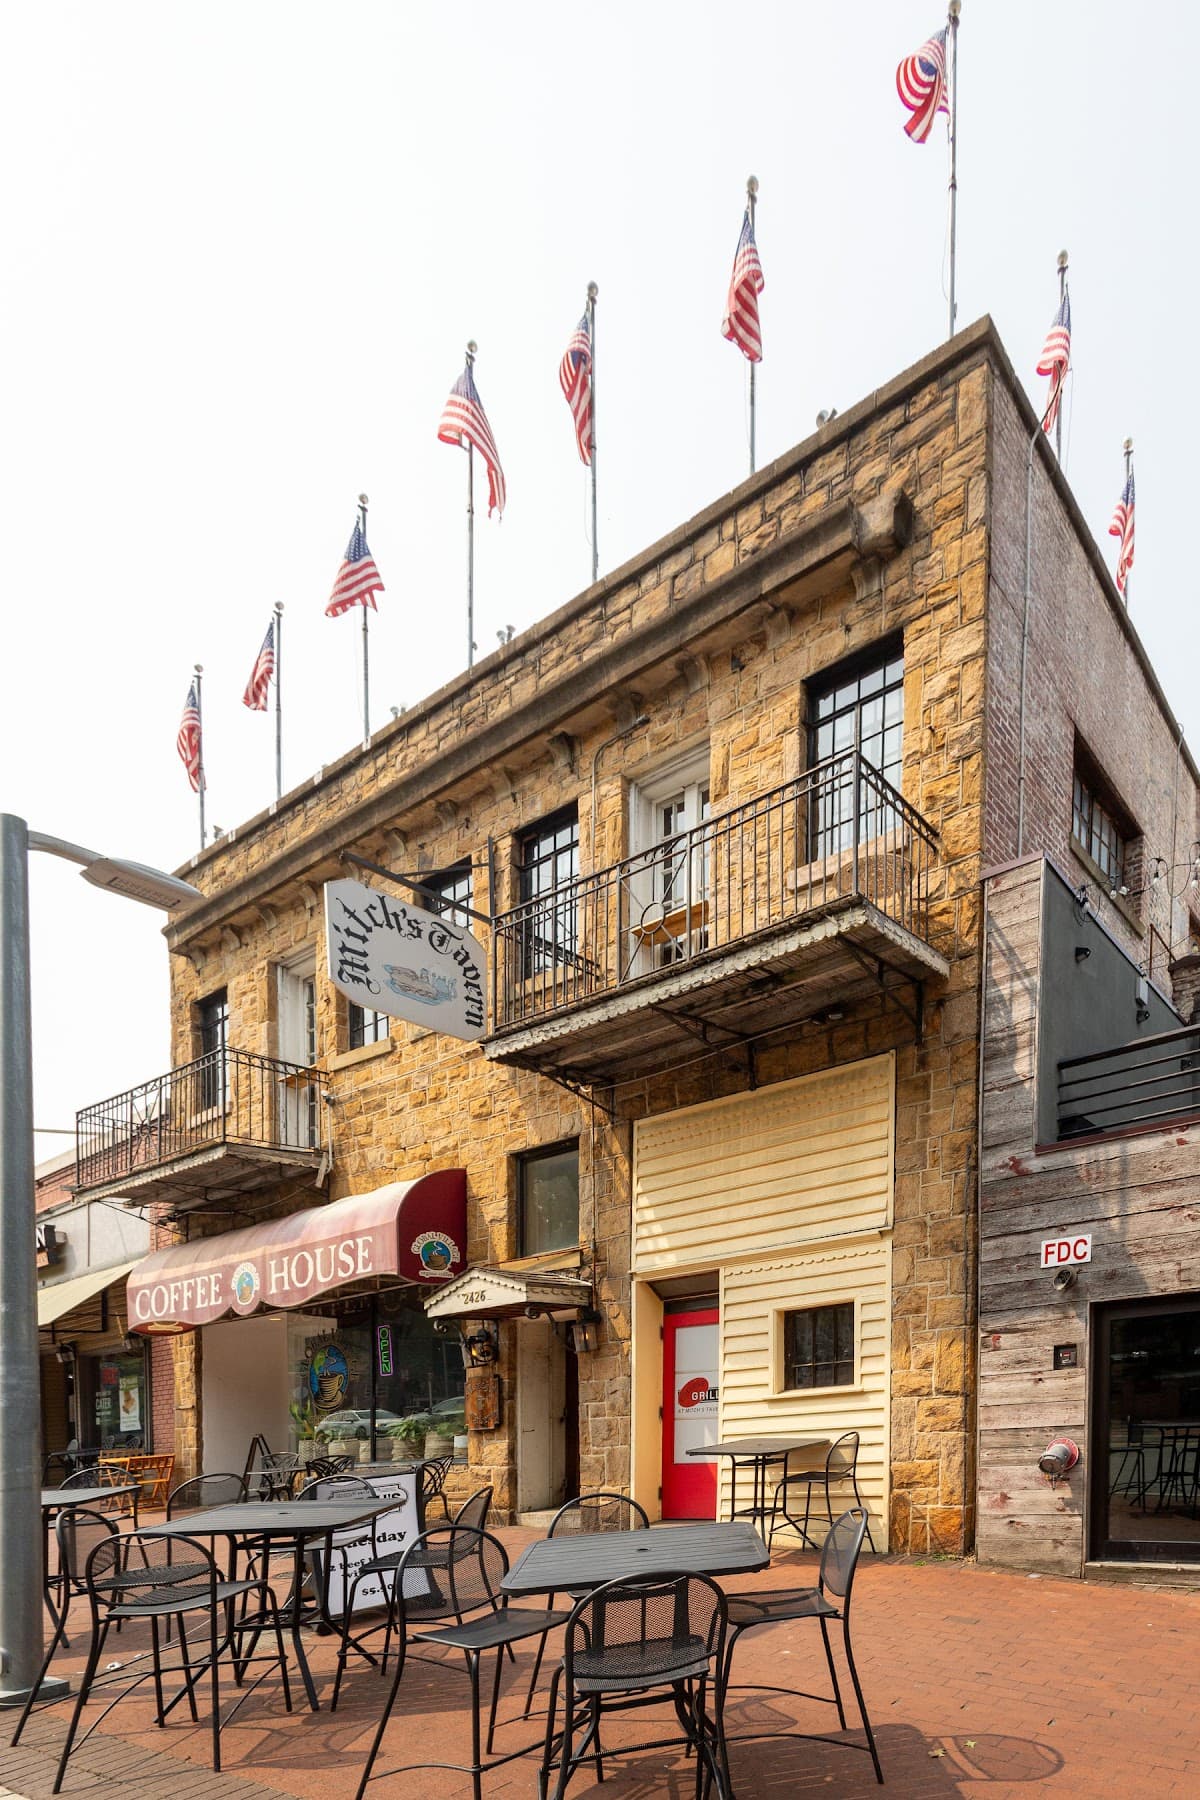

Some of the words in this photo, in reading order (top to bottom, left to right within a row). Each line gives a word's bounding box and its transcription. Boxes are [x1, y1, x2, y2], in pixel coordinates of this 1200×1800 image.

[333, 894, 424, 994] Mitch's
[428, 921, 484, 1028] Tavern
[1044, 1238, 1088, 1265] FDC
[135, 1272, 223, 1320] COFFEE
[269, 1236, 373, 1295] HOUSE
[462, 1290, 486, 1304] 2426
[380, 1327, 391, 1373] OPEN
[345, 1531, 407, 1549] uesday
